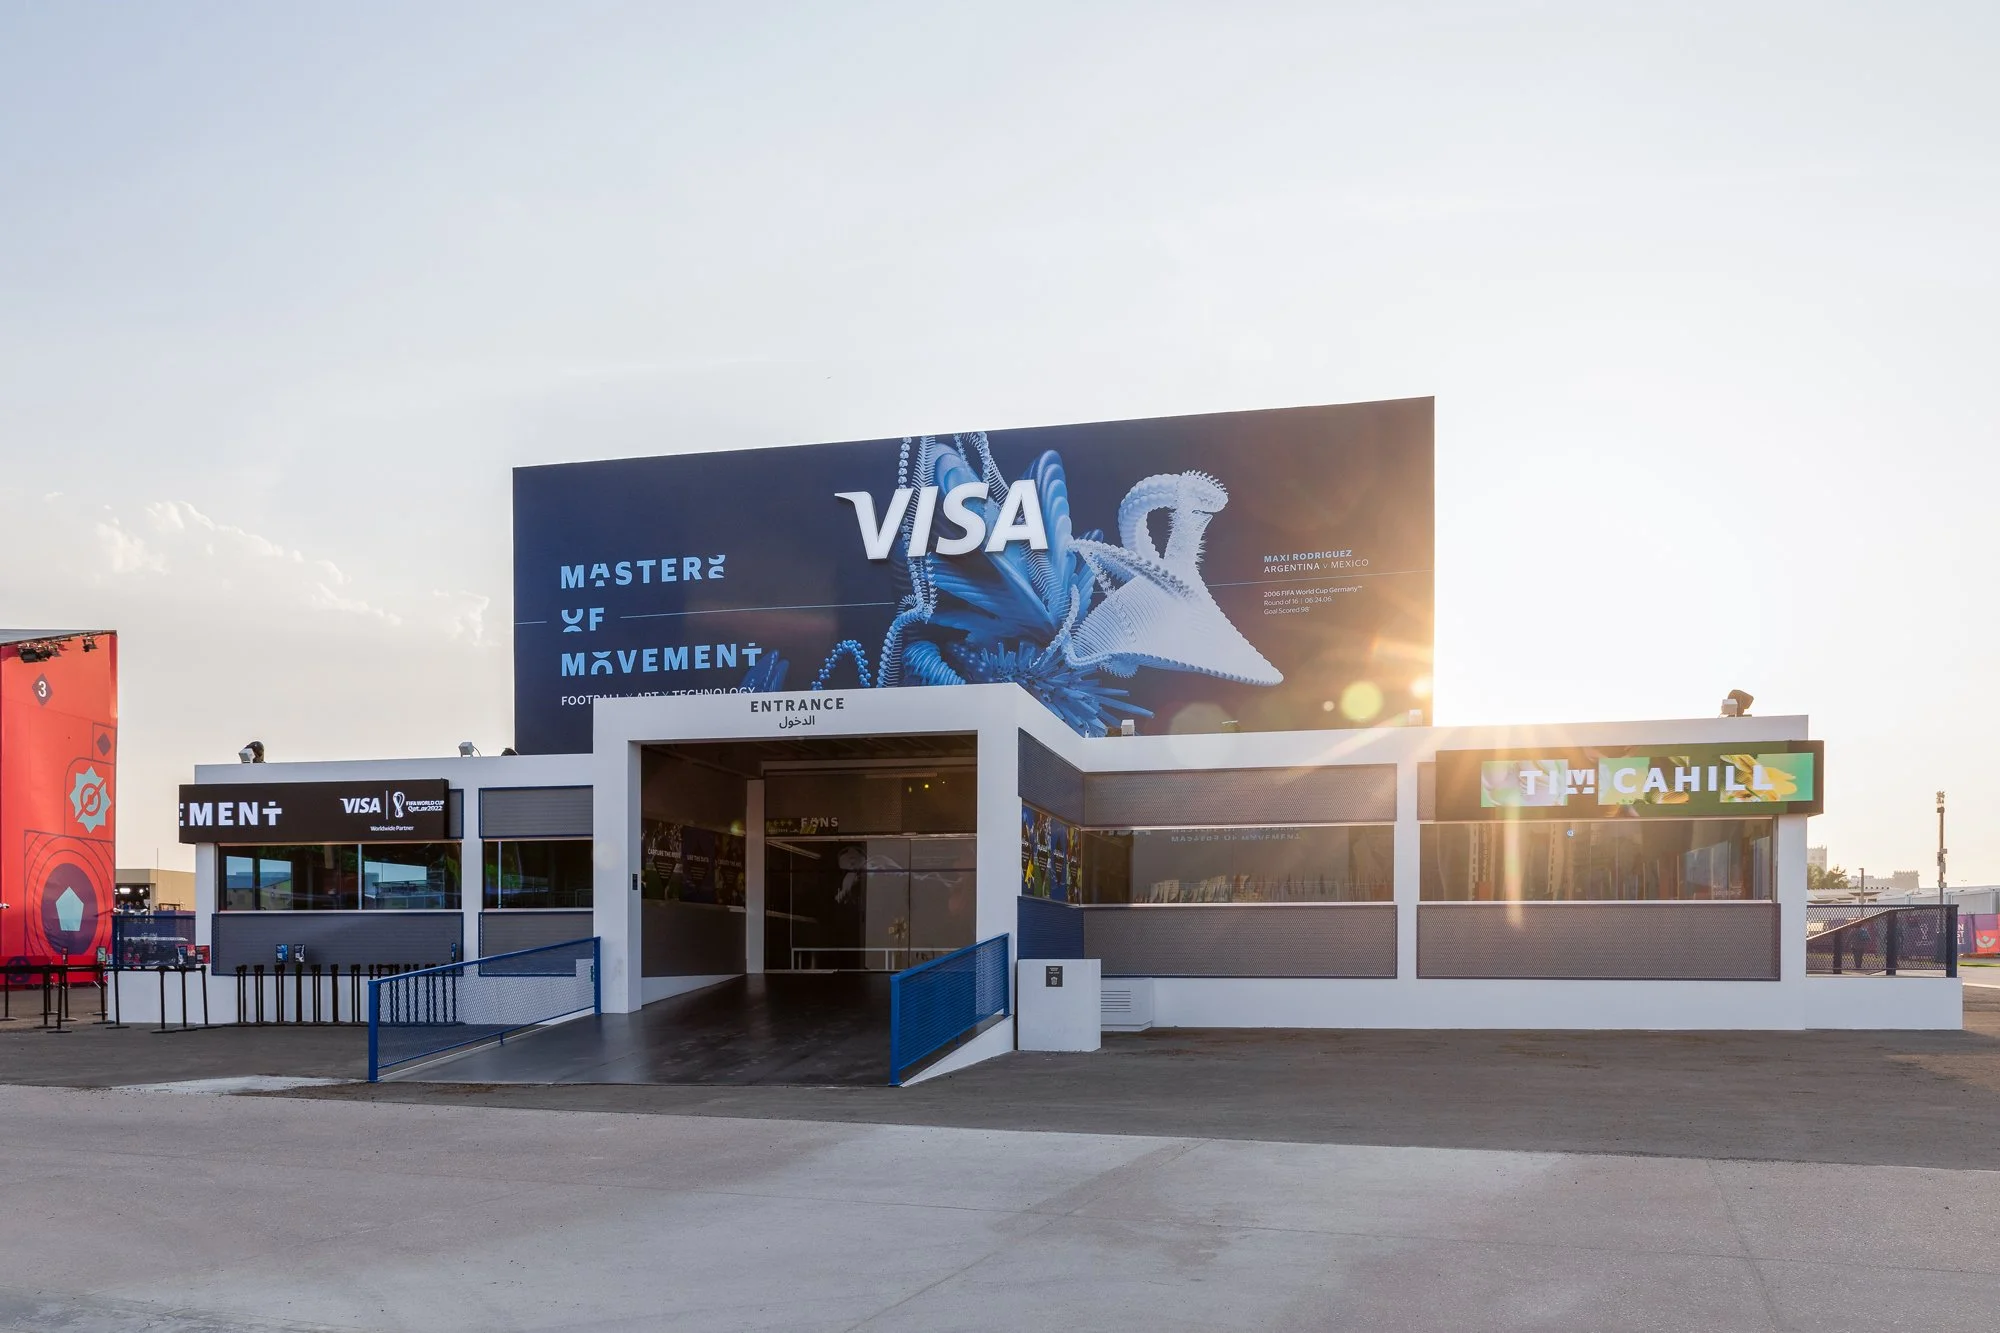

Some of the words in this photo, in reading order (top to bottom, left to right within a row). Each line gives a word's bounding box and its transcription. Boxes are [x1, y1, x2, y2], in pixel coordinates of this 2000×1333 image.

[834, 479, 1049, 560] VISA
[1263, 555, 1290, 563] MAXI
[1292, 549, 1352, 561] RODRIGUEZ
[560, 554, 726, 589] MASTERS
[1263, 563, 1320, 573] ARGENTINA
[1331, 559, 1369, 569] MEXICO
[1263, 590, 1281, 598] 2006
[1281, 588, 1295, 596] FIFA
[1315, 587, 1329, 595] Cup
[1263, 598, 1283, 606] Round
[1292, 597, 1299, 605] 16
[1263, 607, 1278, 615] Goal
[1278, 606, 1300, 614] Scored
[561, 607, 605, 632] OF
[561, 642, 762, 677] MOVEMENT
[38, 680, 47, 698] 3
[750, 697, 845, 713] ENTRANCE
[778, 715, 815, 729] الدخول
[1519, 768, 1596, 795] TIM
[1612, 764, 1774, 794] CAHILL
[339, 797, 382, 814] VISA
